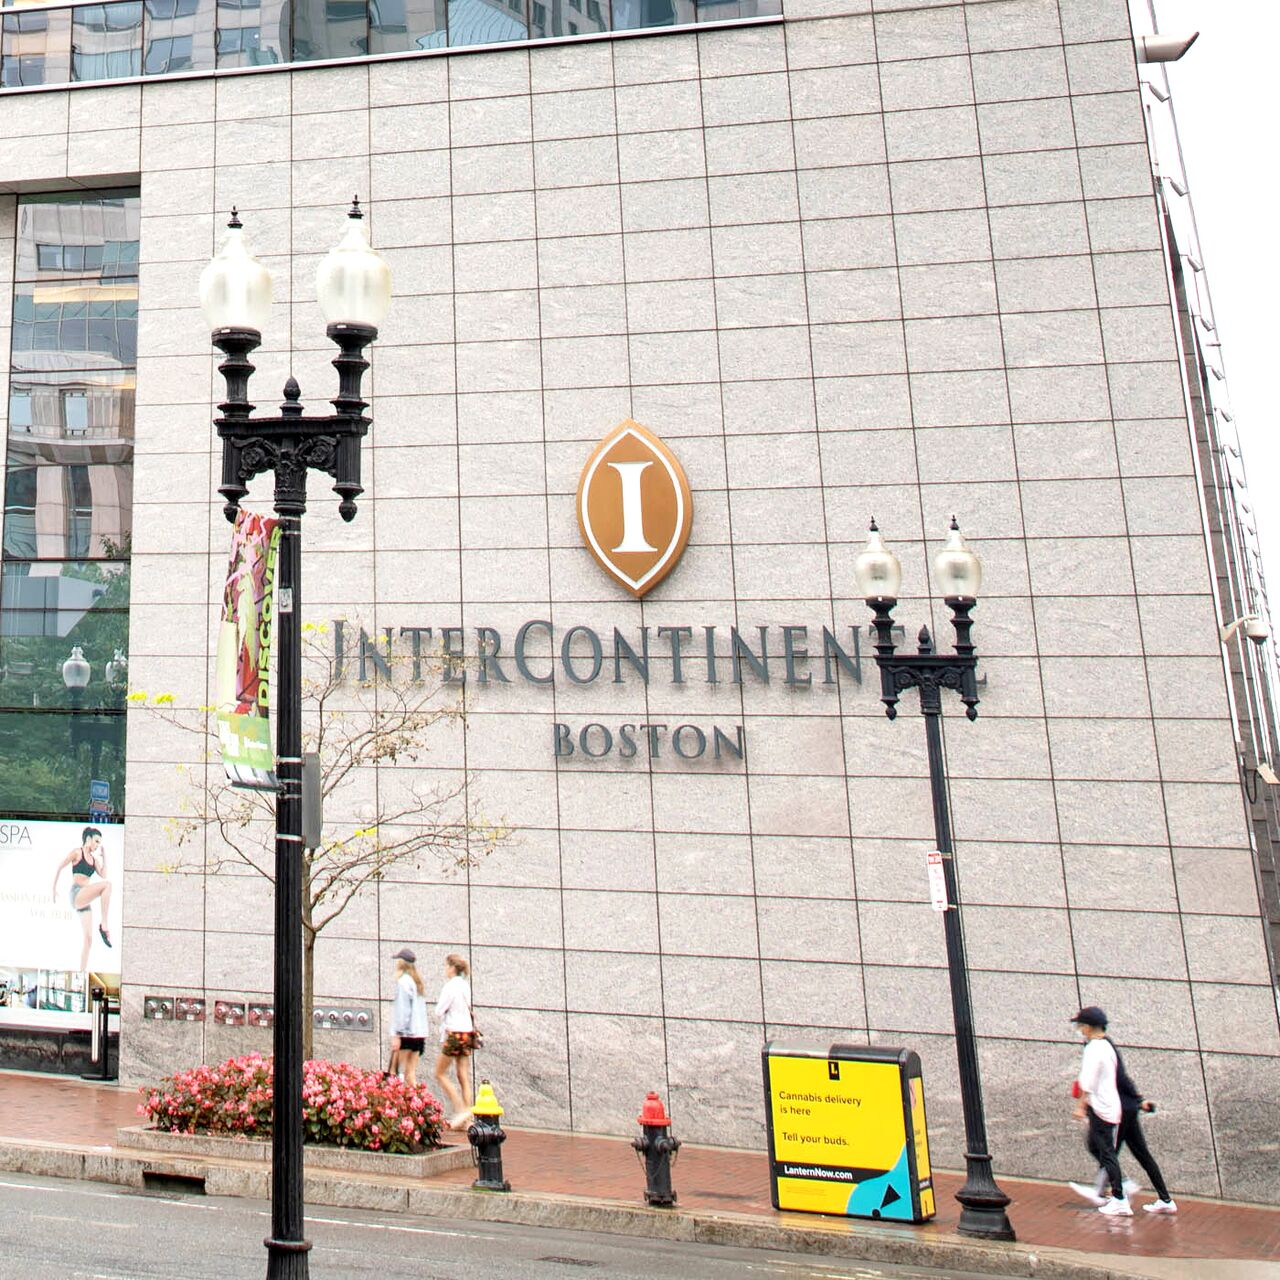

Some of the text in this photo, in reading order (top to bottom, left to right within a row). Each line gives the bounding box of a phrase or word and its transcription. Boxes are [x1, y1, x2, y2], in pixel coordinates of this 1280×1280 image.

[258, 526, 282, 707] DISCOVER
[553, 723, 745, 761] BOSTON
[0, 824, 32, 845] SPA
[779, 1091, 862, 1107] Cannabis delivery
[780, 1104, 811, 1116] is here
[782, 1132, 850, 1146] Tell your buds.
[784, 1165, 853, 1180] LanternNow.com
